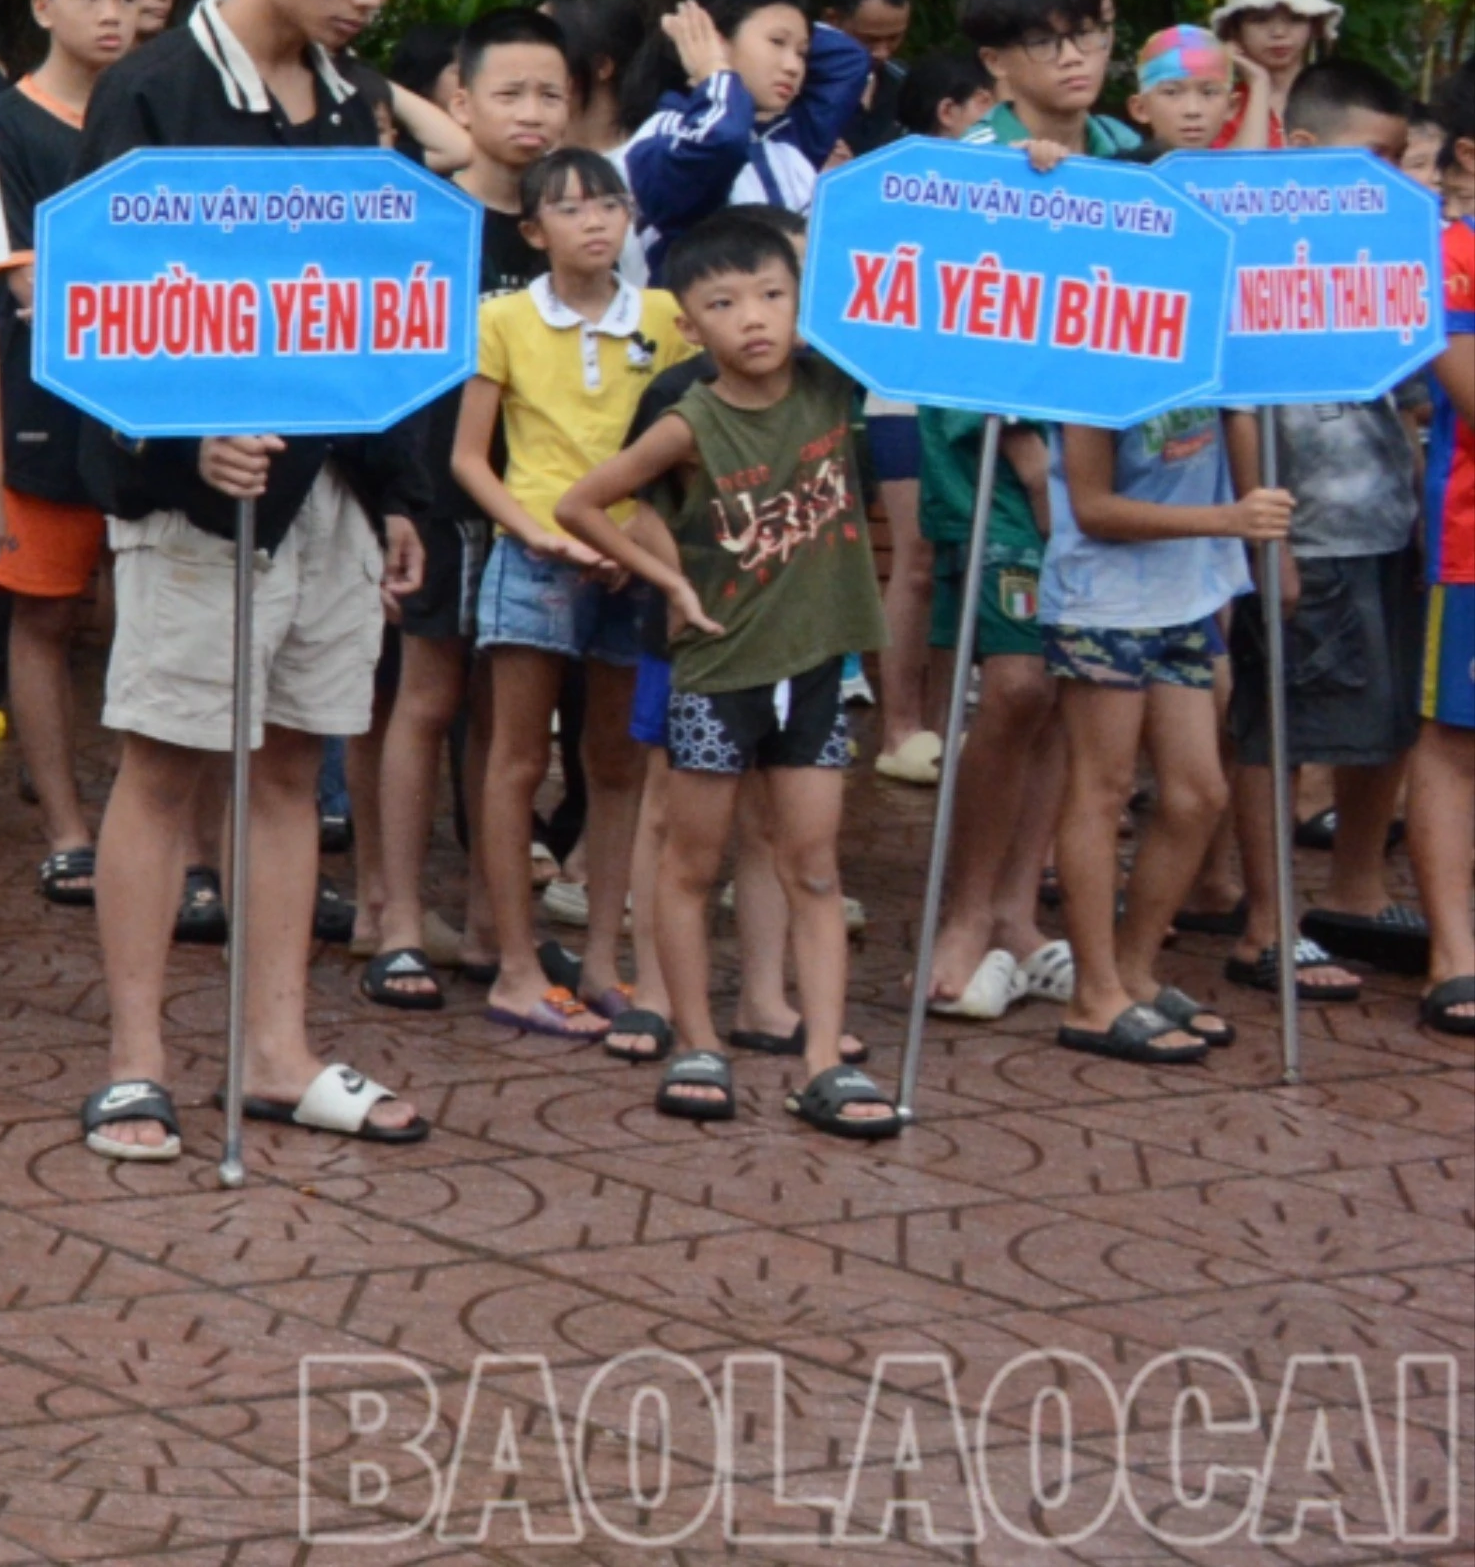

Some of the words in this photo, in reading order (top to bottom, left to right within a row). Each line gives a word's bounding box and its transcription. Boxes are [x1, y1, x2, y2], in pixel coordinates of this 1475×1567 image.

[110, 186, 194, 225] ĐOÀN
[201, 187, 257, 236] VẬN
[264, 186, 345, 232] ĐỘNG
[352, 185, 416, 225] VIÊN
[883, 170, 959, 209] ĐOÀN
[965, 173, 1023, 221] VẬN
[1029, 179, 1107, 234] ĐỘNG
[1112, 192, 1174, 236] VIÊN
[1220, 181, 1265, 224] VẬN
[1269, 180, 1332, 224] ĐỘNG
[1336, 179, 1387, 214] VIÊN
[64, 263, 259, 359] PHƯỜNG
[268, 263, 362, 355] YÊN
[370, 262, 450, 354] BÁI
[844, 244, 919, 329] XÃ
[936, 253, 1044, 344] YÊN
[1050, 263, 1190, 362] BÌNH
[1329, 250, 1379, 331] THÁI
[1383, 262, 1430, 344] HỌC
